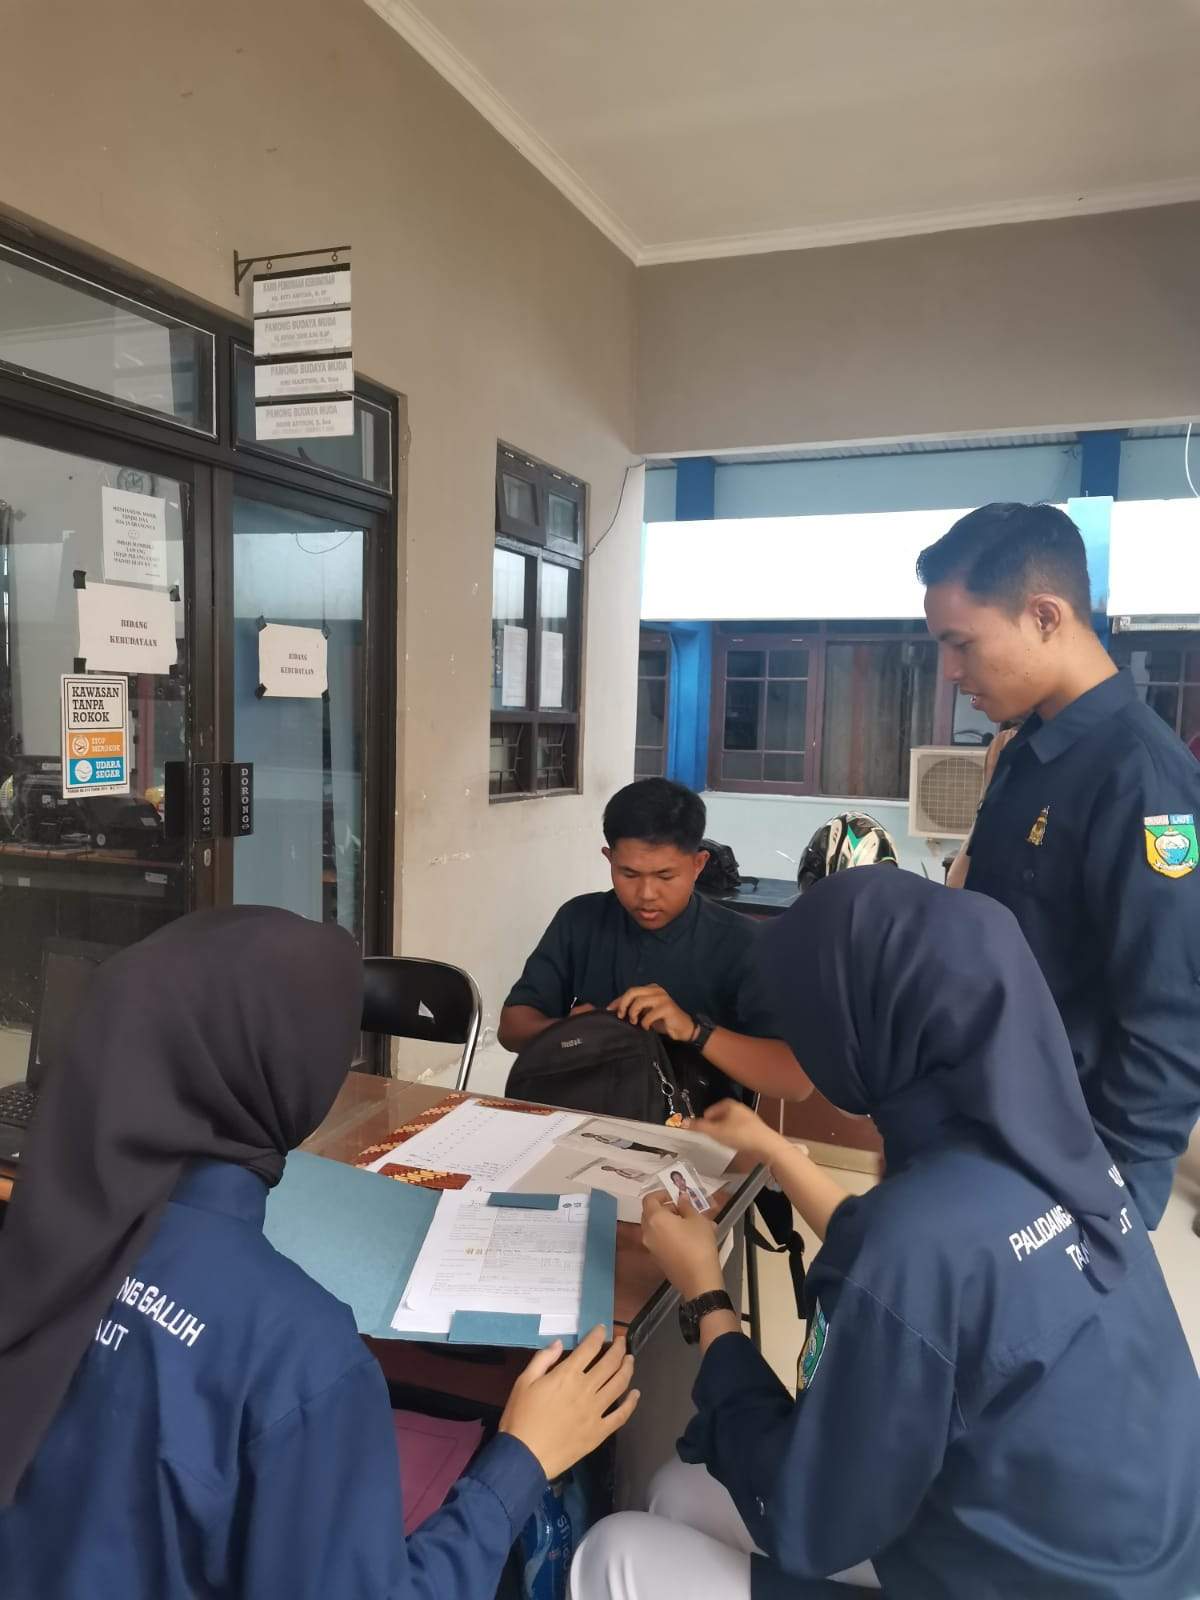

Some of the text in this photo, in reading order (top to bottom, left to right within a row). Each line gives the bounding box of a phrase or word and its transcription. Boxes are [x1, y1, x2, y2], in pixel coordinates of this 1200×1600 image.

[120, 619, 149, 630] BIDANG
[109, 635, 158, 648] KEBUDAYAAN
[72, 686, 120, 699] KAWASAN
[72, 699, 105, 710] TANPA
[73, 711, 110, 723] ROKOK
[95, 760, 121, 769] UDARA
[95, 769, 121, 779] SEGAR
[202, 768, 210, 825] DORONG
[241, 768, 249, 823] DORONG
[137, 1285, 206, 1348] GALUH
